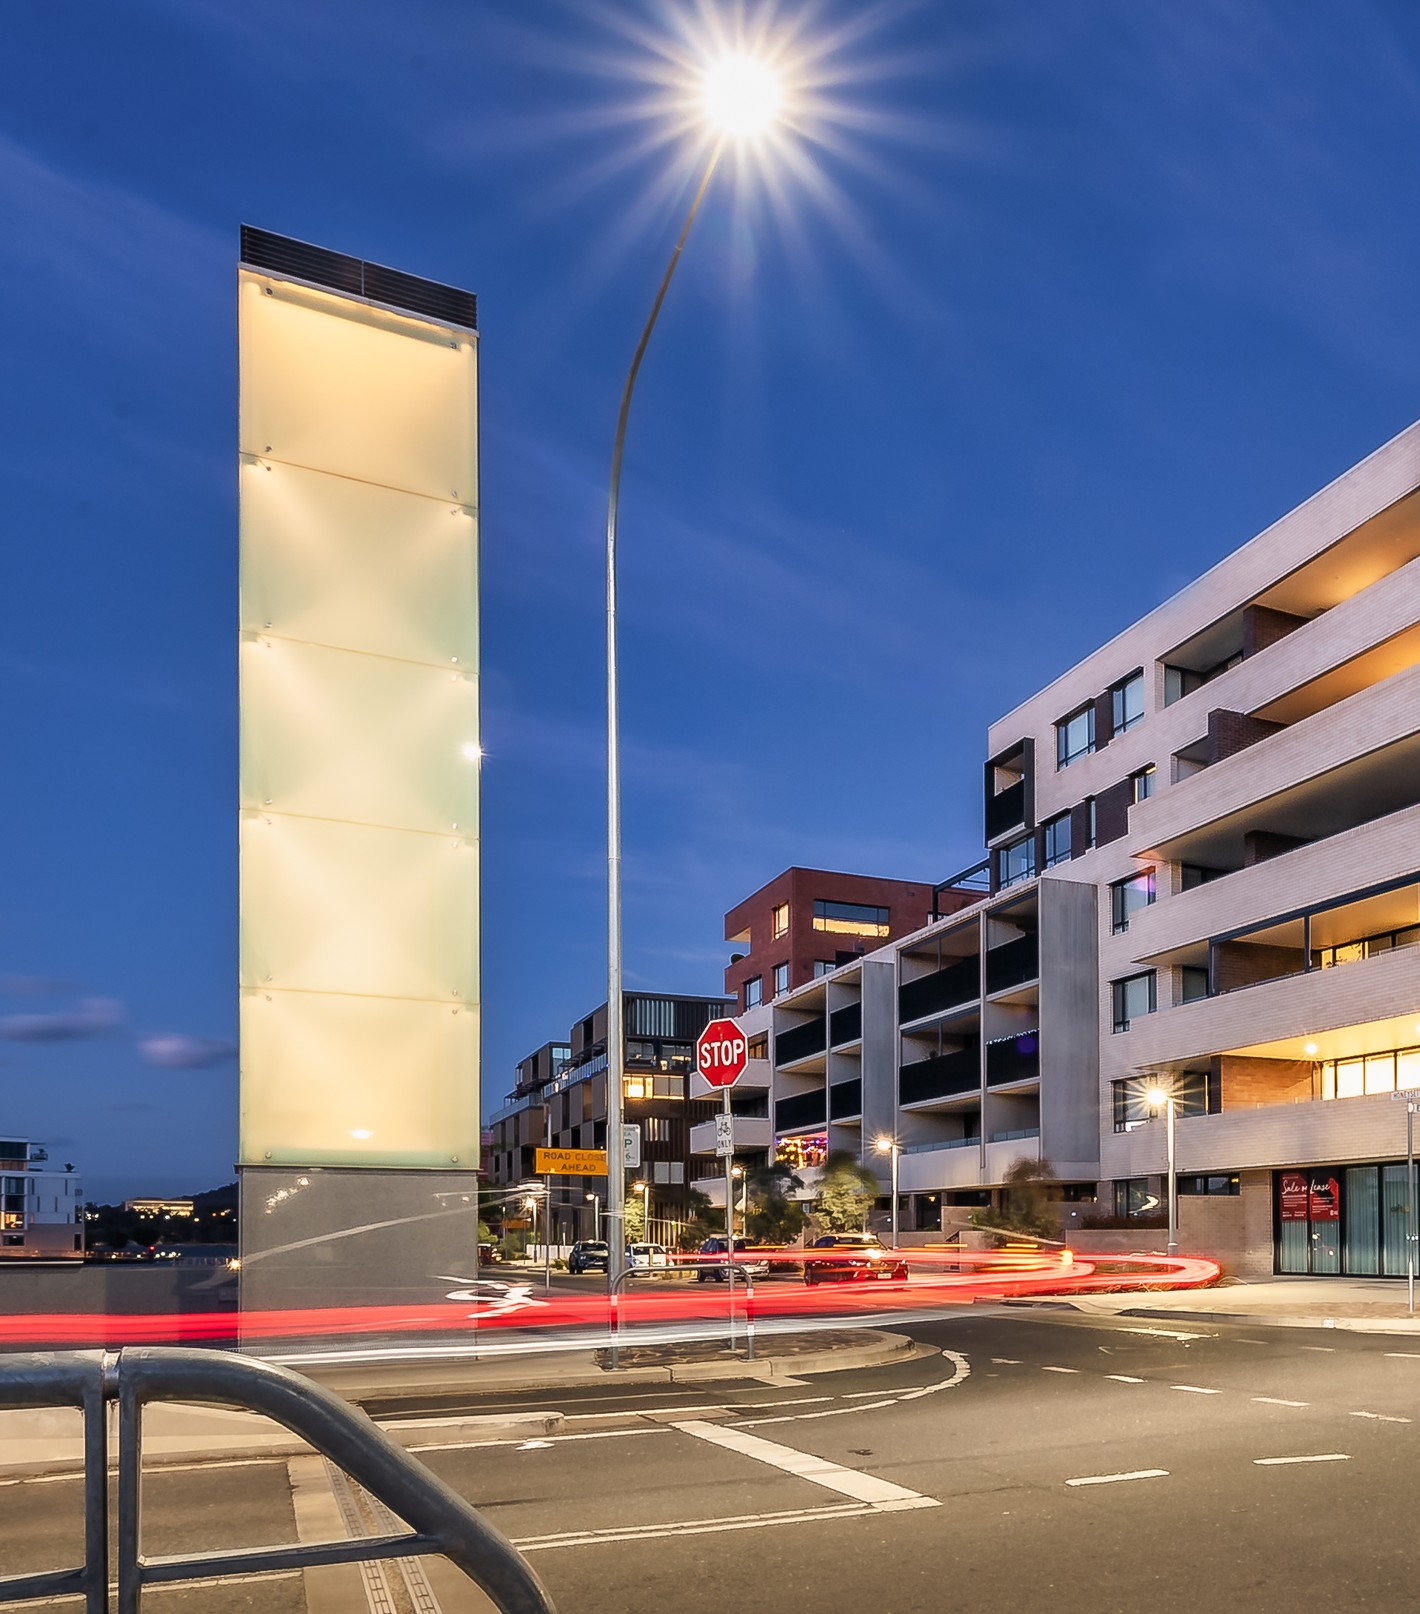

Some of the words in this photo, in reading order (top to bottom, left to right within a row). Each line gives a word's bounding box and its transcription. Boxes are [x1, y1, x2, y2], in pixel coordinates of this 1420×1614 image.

[701, 1039, 744, 1069] STOP
[624, 1138, 633, 1149] P
[717, 1139, 732, 1149] ONLY
[543, 1151, 571, 1161] ROAD
[575, 1153, 606, 1161] CLOSE
[625, 1152, 632, 1160] 6
[561, 1163, 596, 1172] AHEAD
[1281, 1179, 1300, 1195] Sale
[1309, 1178, 1331, 1195] Lease
